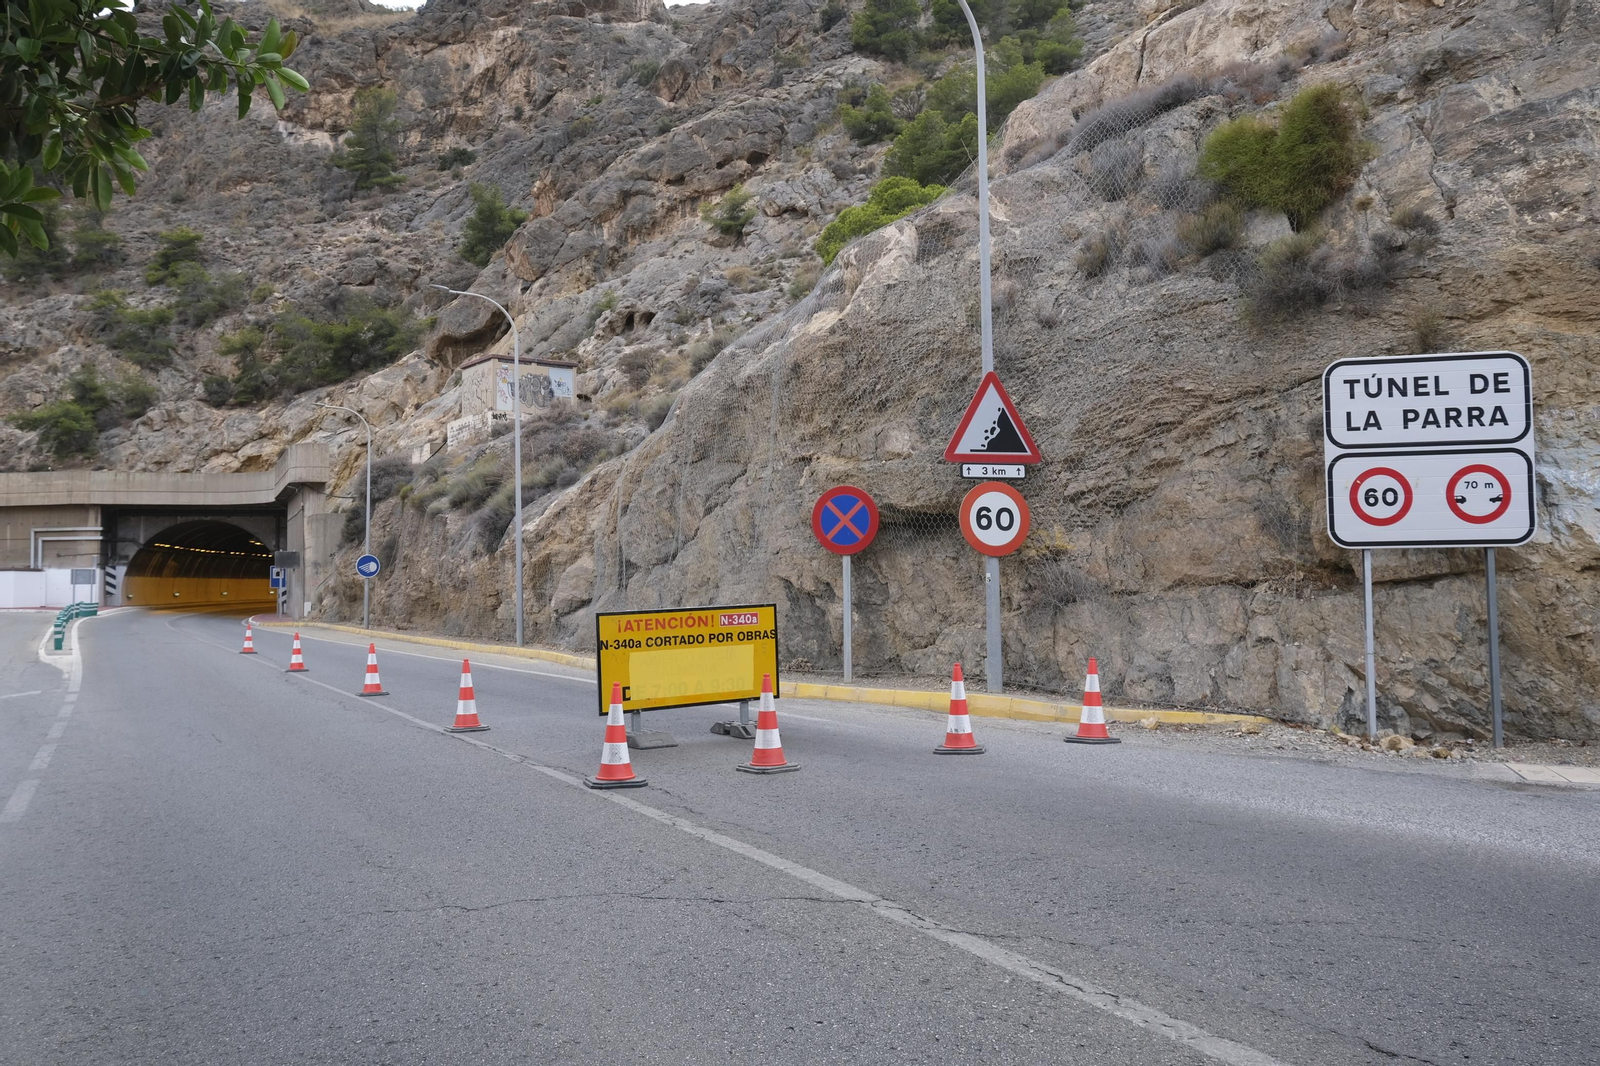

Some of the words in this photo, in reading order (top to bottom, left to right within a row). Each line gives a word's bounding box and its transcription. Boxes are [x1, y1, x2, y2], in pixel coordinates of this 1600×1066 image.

[1343, 373, 1449, 399] TÚNEL
[1469, 372, 1511, 395] DE
[1346, 410, 1382, 432] LA
[1403, 405, 1509, 429] PARRA
[981, 467, 988, 475] 3
[992, 467, 1006, 475] km
[1464, 481, 1478, 490] 70
[1364, 487, 1399, 507] 60
[976, 506, 1014, 531] 60
[617, 613, 715, 633] ¡ATENCIÓN!
[721, 614, 758, 625] N-340a
[600, 637, 642, 650] N-340a
[646, 634, 705, 648] CORTADO
[709, 632, 733, 643] POR
[737, 629, 776, 642] OBRAS
